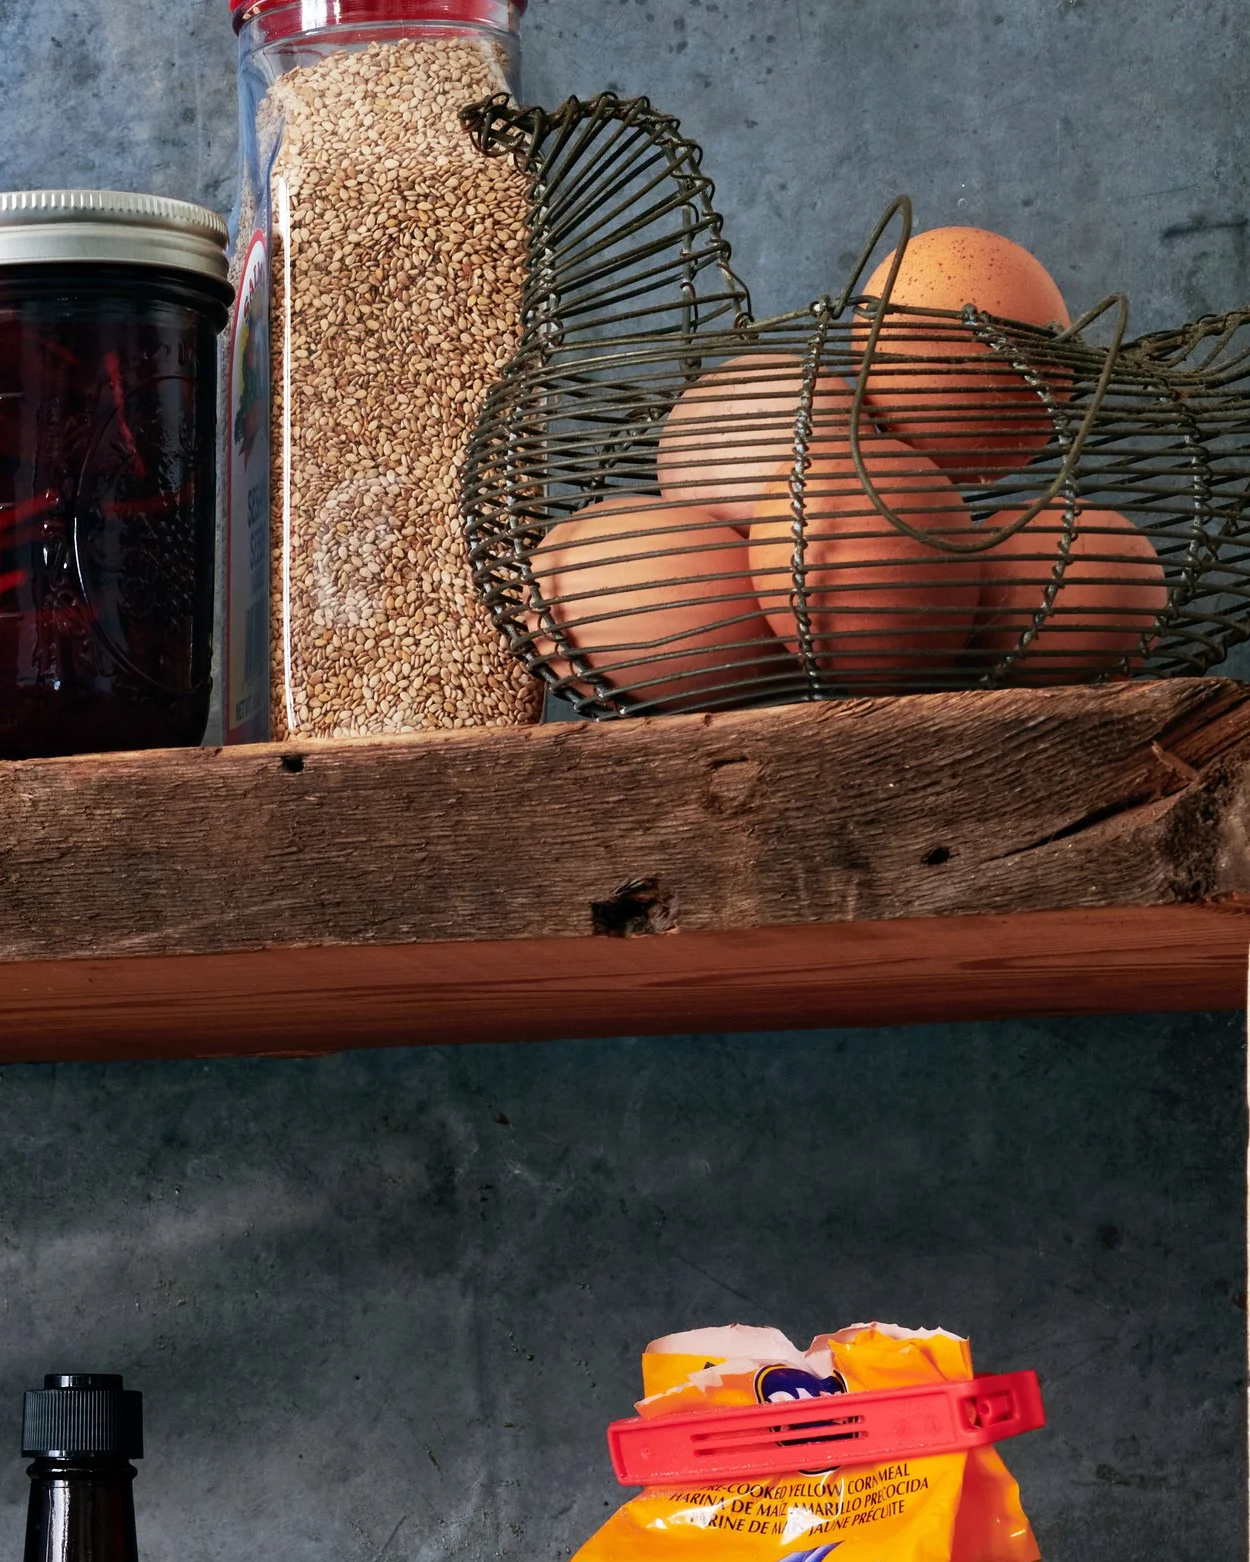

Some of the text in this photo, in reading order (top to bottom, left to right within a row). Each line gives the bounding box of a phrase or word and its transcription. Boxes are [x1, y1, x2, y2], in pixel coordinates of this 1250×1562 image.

[670, 1492, 726, 1511] HARINA
[731, 1500, 753, 1515] DE
[864, 1477, 929, 1508] PRECOCIDA
[788, 1482, 842, 1498] YELLOW
[748, 1520, 770, 1535] DE
[808, 1517, 850, 1537] JAUNE
[851, 1500, 906, 1527] PRÉCUITE
